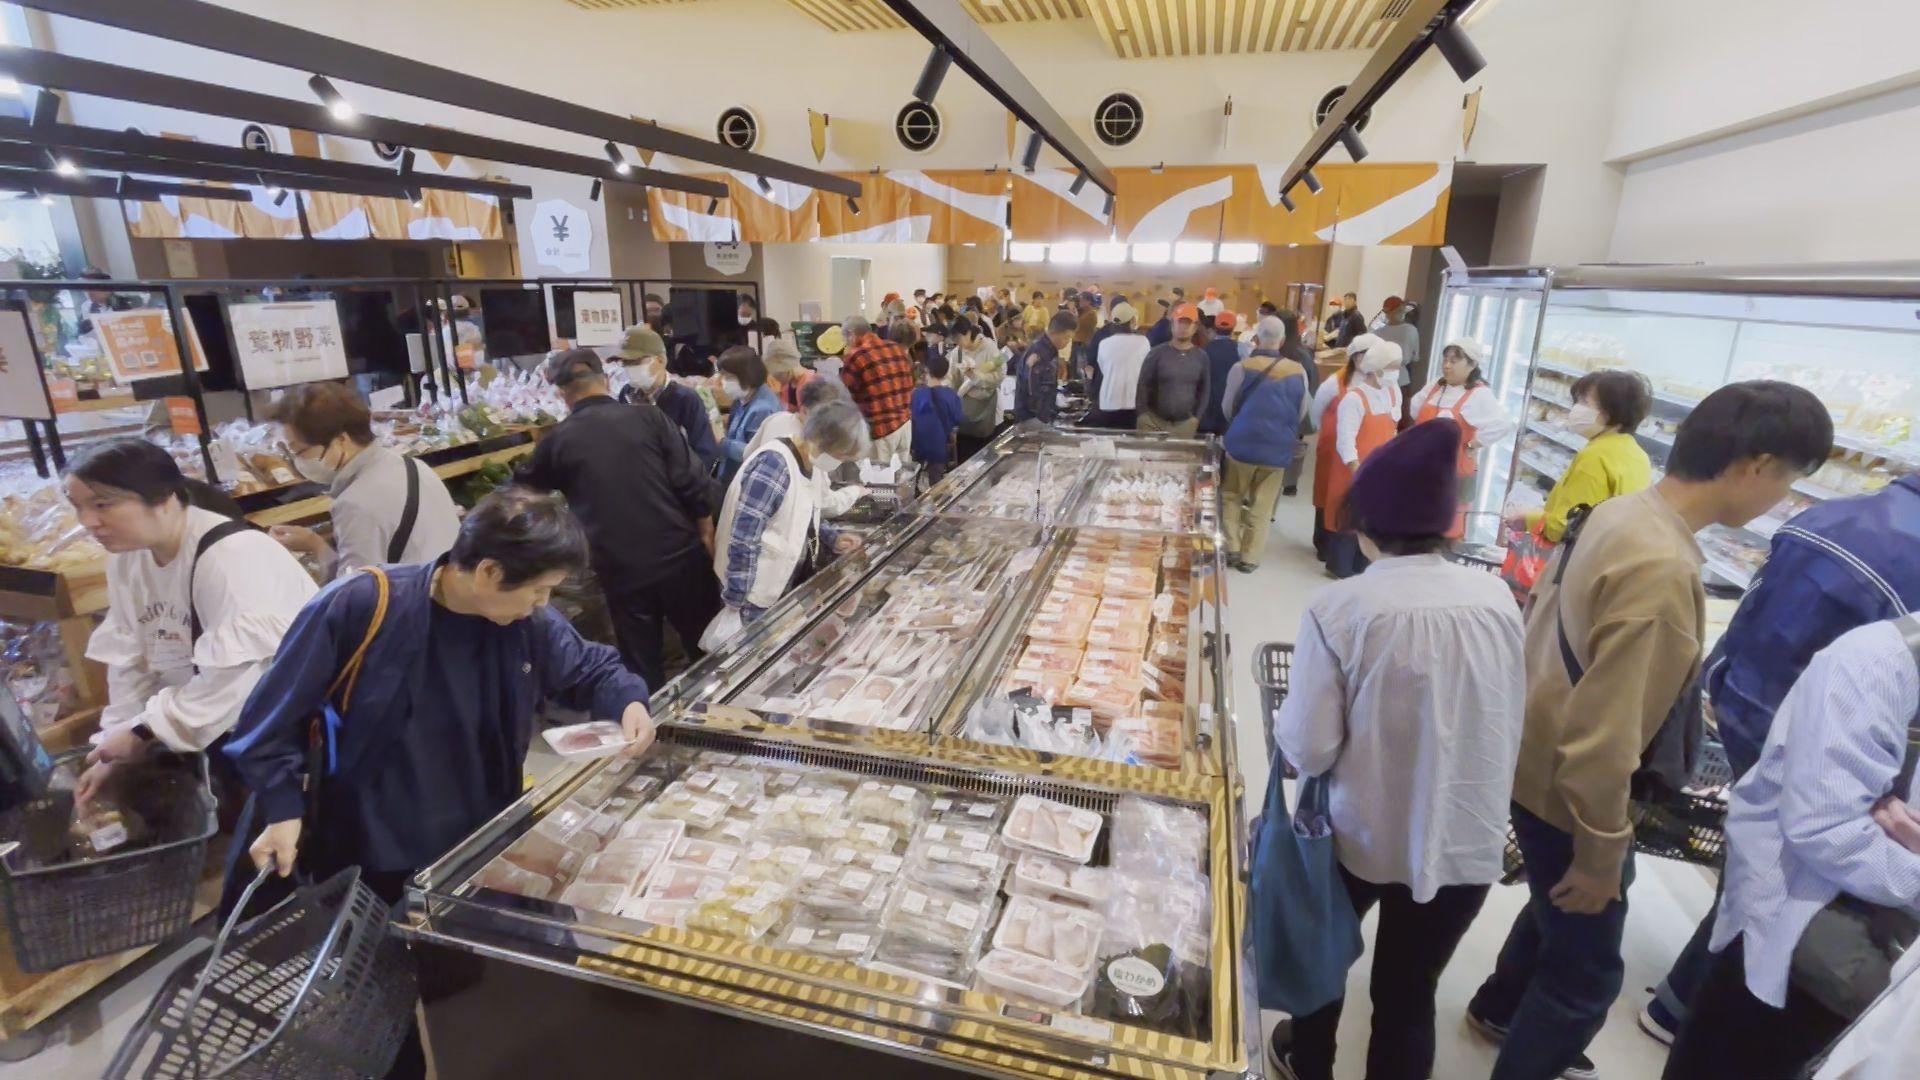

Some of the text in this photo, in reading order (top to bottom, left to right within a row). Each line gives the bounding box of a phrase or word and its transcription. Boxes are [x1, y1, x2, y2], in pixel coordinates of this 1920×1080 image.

[549, 214, 570, 242] ¥
[580, 308, 618, 324] 葉物野菜
[248, 325, 337, 354] 葉物野菜
